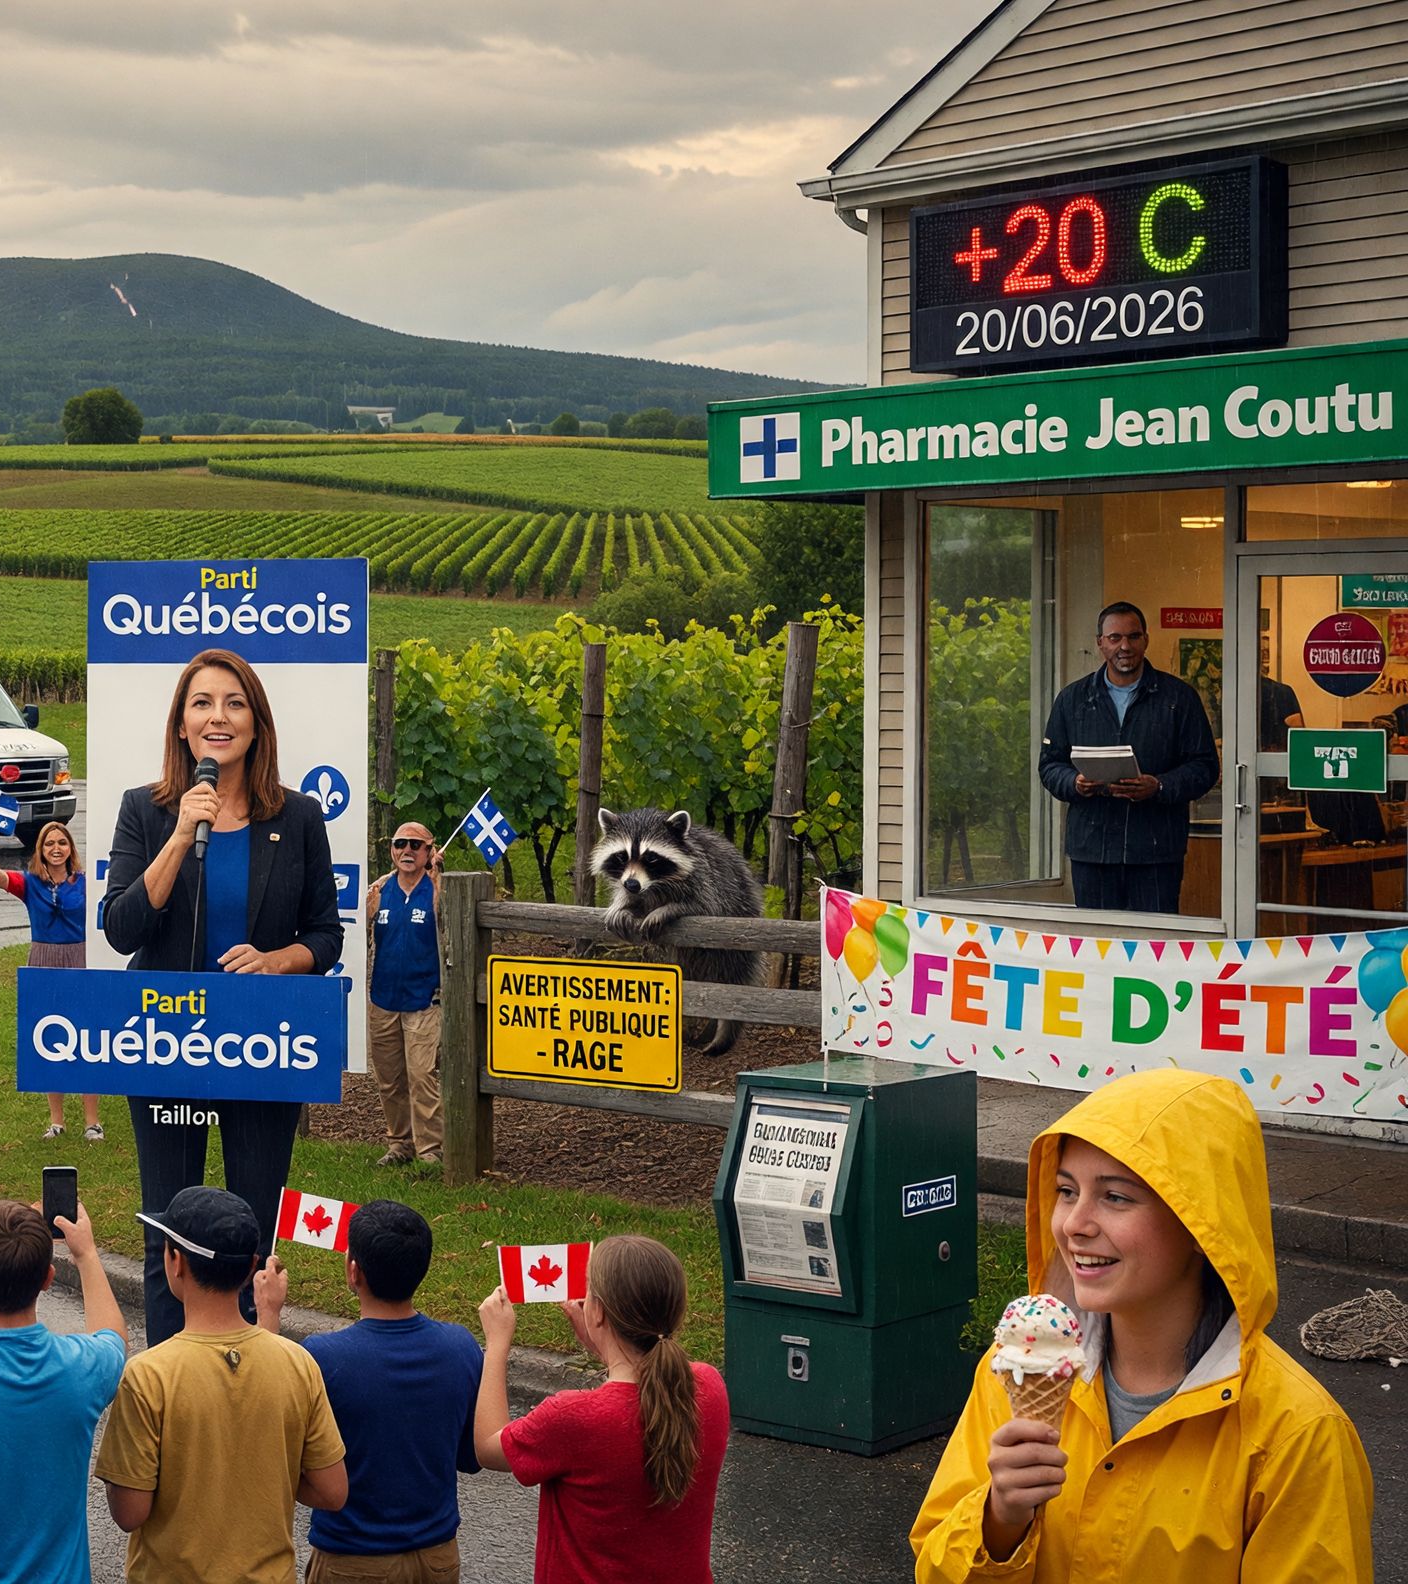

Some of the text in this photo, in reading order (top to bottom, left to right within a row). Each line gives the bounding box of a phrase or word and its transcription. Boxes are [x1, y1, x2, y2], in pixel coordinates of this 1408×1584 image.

[954, 183, 1206, 293] +20 C
[955, 286, 1205, 356] 20/06/2026
[821, 382, 1393, 468] Pharmacie Jean Coutu
[201, 567, 257, 590] Parti
[102, 592, 352, 636] Québécois
[141, 988, 206, 1015] Parti
[500, 973, 671, 1005] AVERTISSEMENT:
[911, 940, 1086, 1038] FÊTE
[499, 1003, 670, 1038] SANTÉ PUBLIQUE
[32, 1014, 319, 1070] Québécois
[553, 1038, 623, 1073] RAGE
[148, 1104, 219, 1126] Taillon
